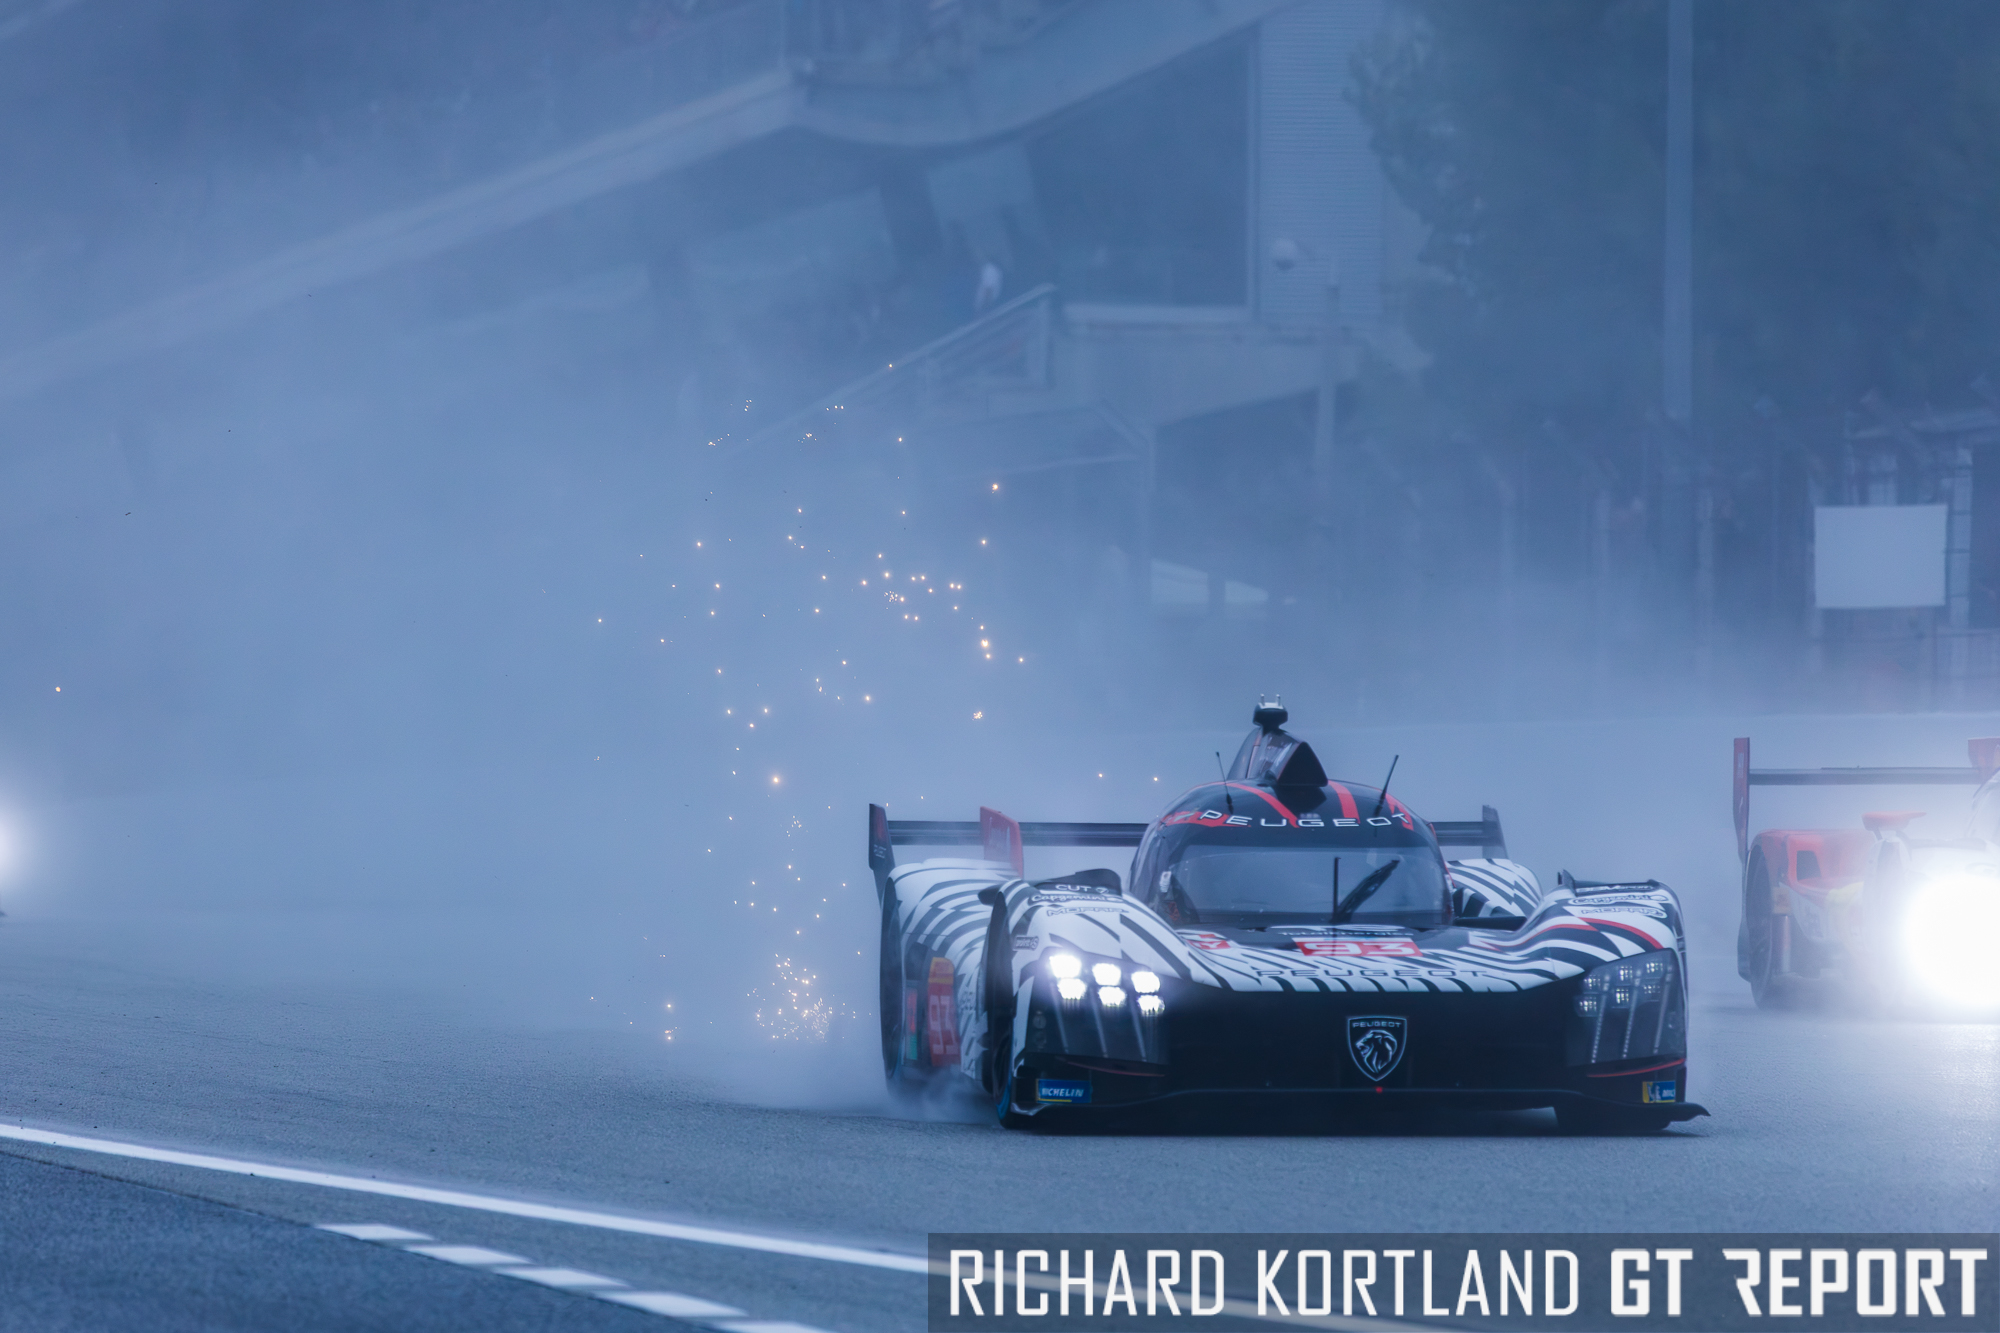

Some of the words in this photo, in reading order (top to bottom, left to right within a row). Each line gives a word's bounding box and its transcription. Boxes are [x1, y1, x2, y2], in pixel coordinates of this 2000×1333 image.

[1199, 809, 1411, 828] PEUGEOT
[1054, 884, 1092, 893] CUT
[1031, 894, 1107, 904] Capgemini
[1303, 942, 1416, 955] 93
[1256, 968, 1488, 978] PEUGEOT
[929, 994, 959, 1055] 93
[1352, 1021, 1402, 1029] PEUGEOT
